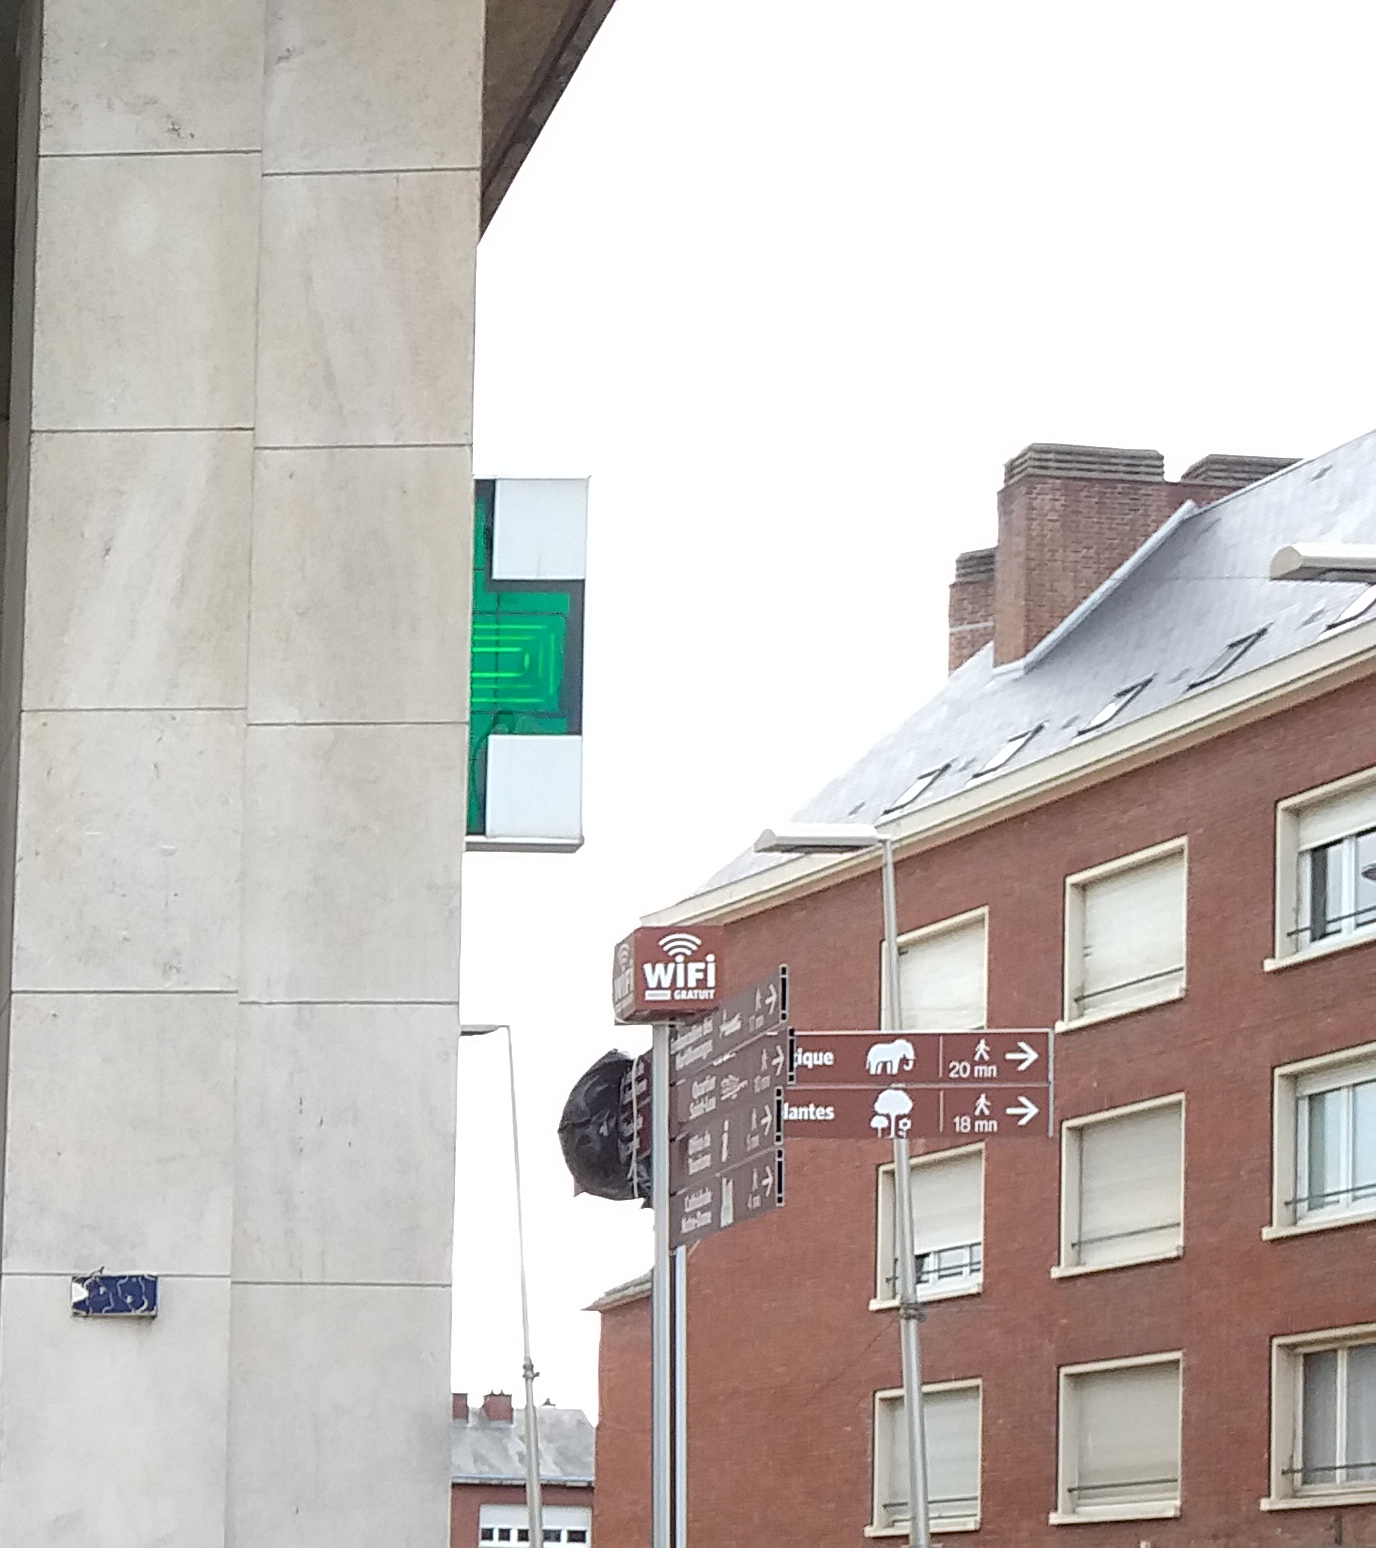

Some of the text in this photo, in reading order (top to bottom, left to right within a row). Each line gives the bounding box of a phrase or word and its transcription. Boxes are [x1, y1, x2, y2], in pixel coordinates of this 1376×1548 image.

[674, 990, 716, 1000] GRATUIT
[794, 1048, 835, 1067] ique
[949, 1062, 997, 1078] 20 mn
[953, 1116, 997, 1133] 18 mn
